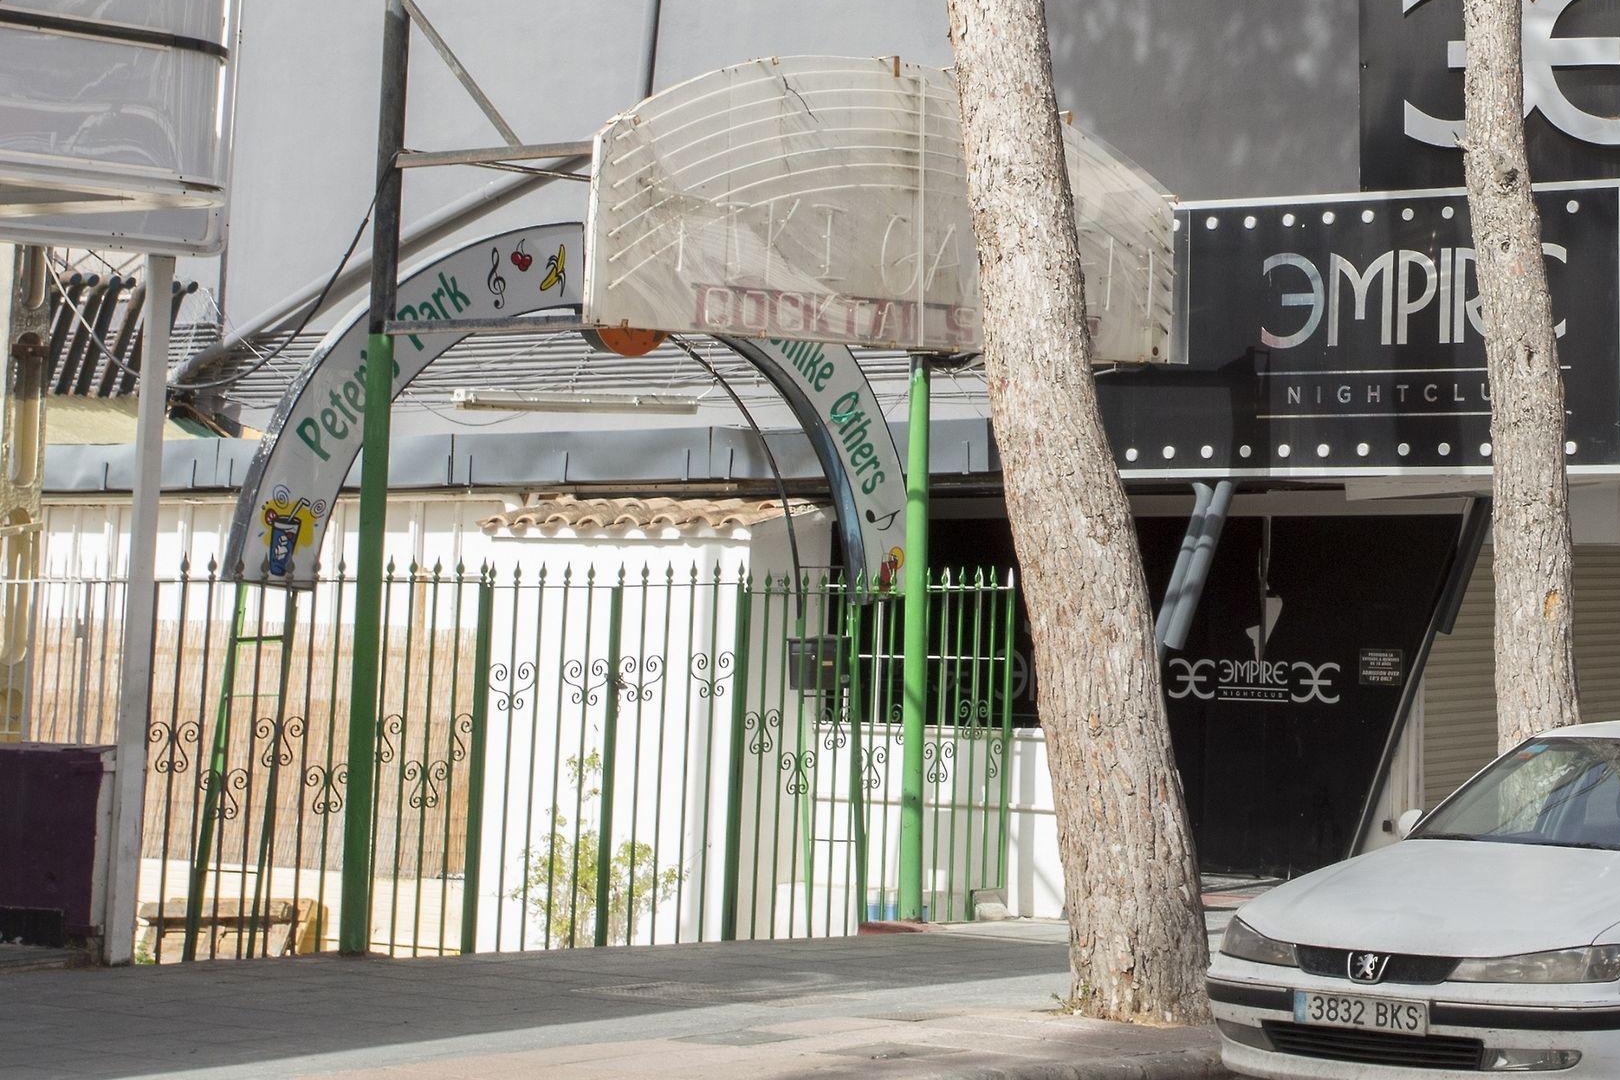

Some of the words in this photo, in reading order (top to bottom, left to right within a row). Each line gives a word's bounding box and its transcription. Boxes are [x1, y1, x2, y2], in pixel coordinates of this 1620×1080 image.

[396, 272, 471, 352] Park
[1261, 242, 1567, 349] EMPIR
[1287, 382, 1493, 404] NIGHTCLU
[830, 391, 885, 495] Others
[1219, 659, 1289, 685] EMPIRE
[1223, 690, 1284, 699] NIGHTCLUB
[1311, 996, 1365, 1025] 3832
[1375, 1002, 1419, 1031] BKS
